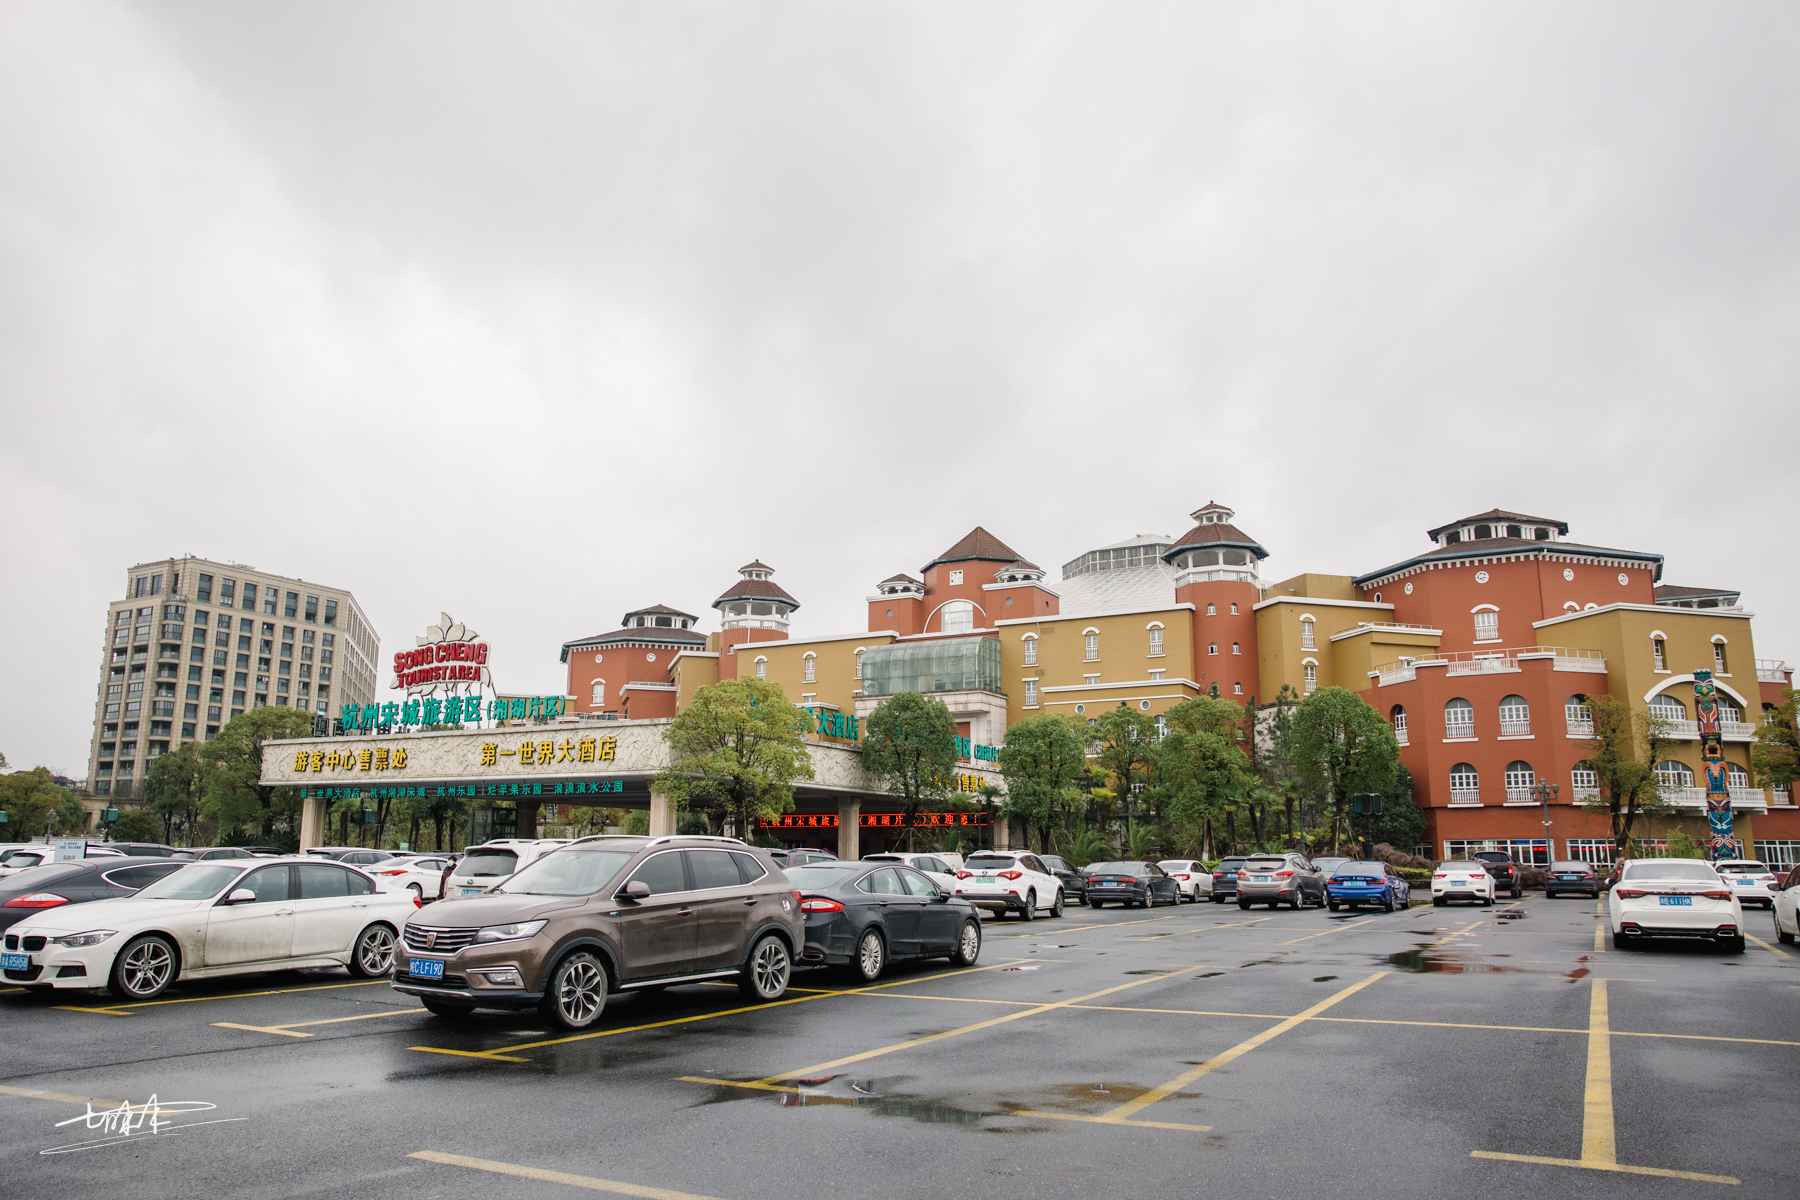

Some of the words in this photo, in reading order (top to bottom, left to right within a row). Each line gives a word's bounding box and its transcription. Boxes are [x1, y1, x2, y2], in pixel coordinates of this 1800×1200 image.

[393, 646, 434, 673] SONG
[434, 642, 488, 665] CHENG
[397, 665, 449, 688] TOURIST
[447, 665, 480, 681] AREA
[293, 747, 407, 772] 游客中心售票处
[480, 736, 617, 766] 第一世界大酒店
[300, 787, 360, 799] 第一世界大酒店
[370, 786, 426, 799] 杭州湘湖宋城
[437, 785, 476, 797] 杭州乐园
[487, 783, 542, 796] 烂苹果乐园
[554, 780, 624, 795] 浪浪浪水公园
